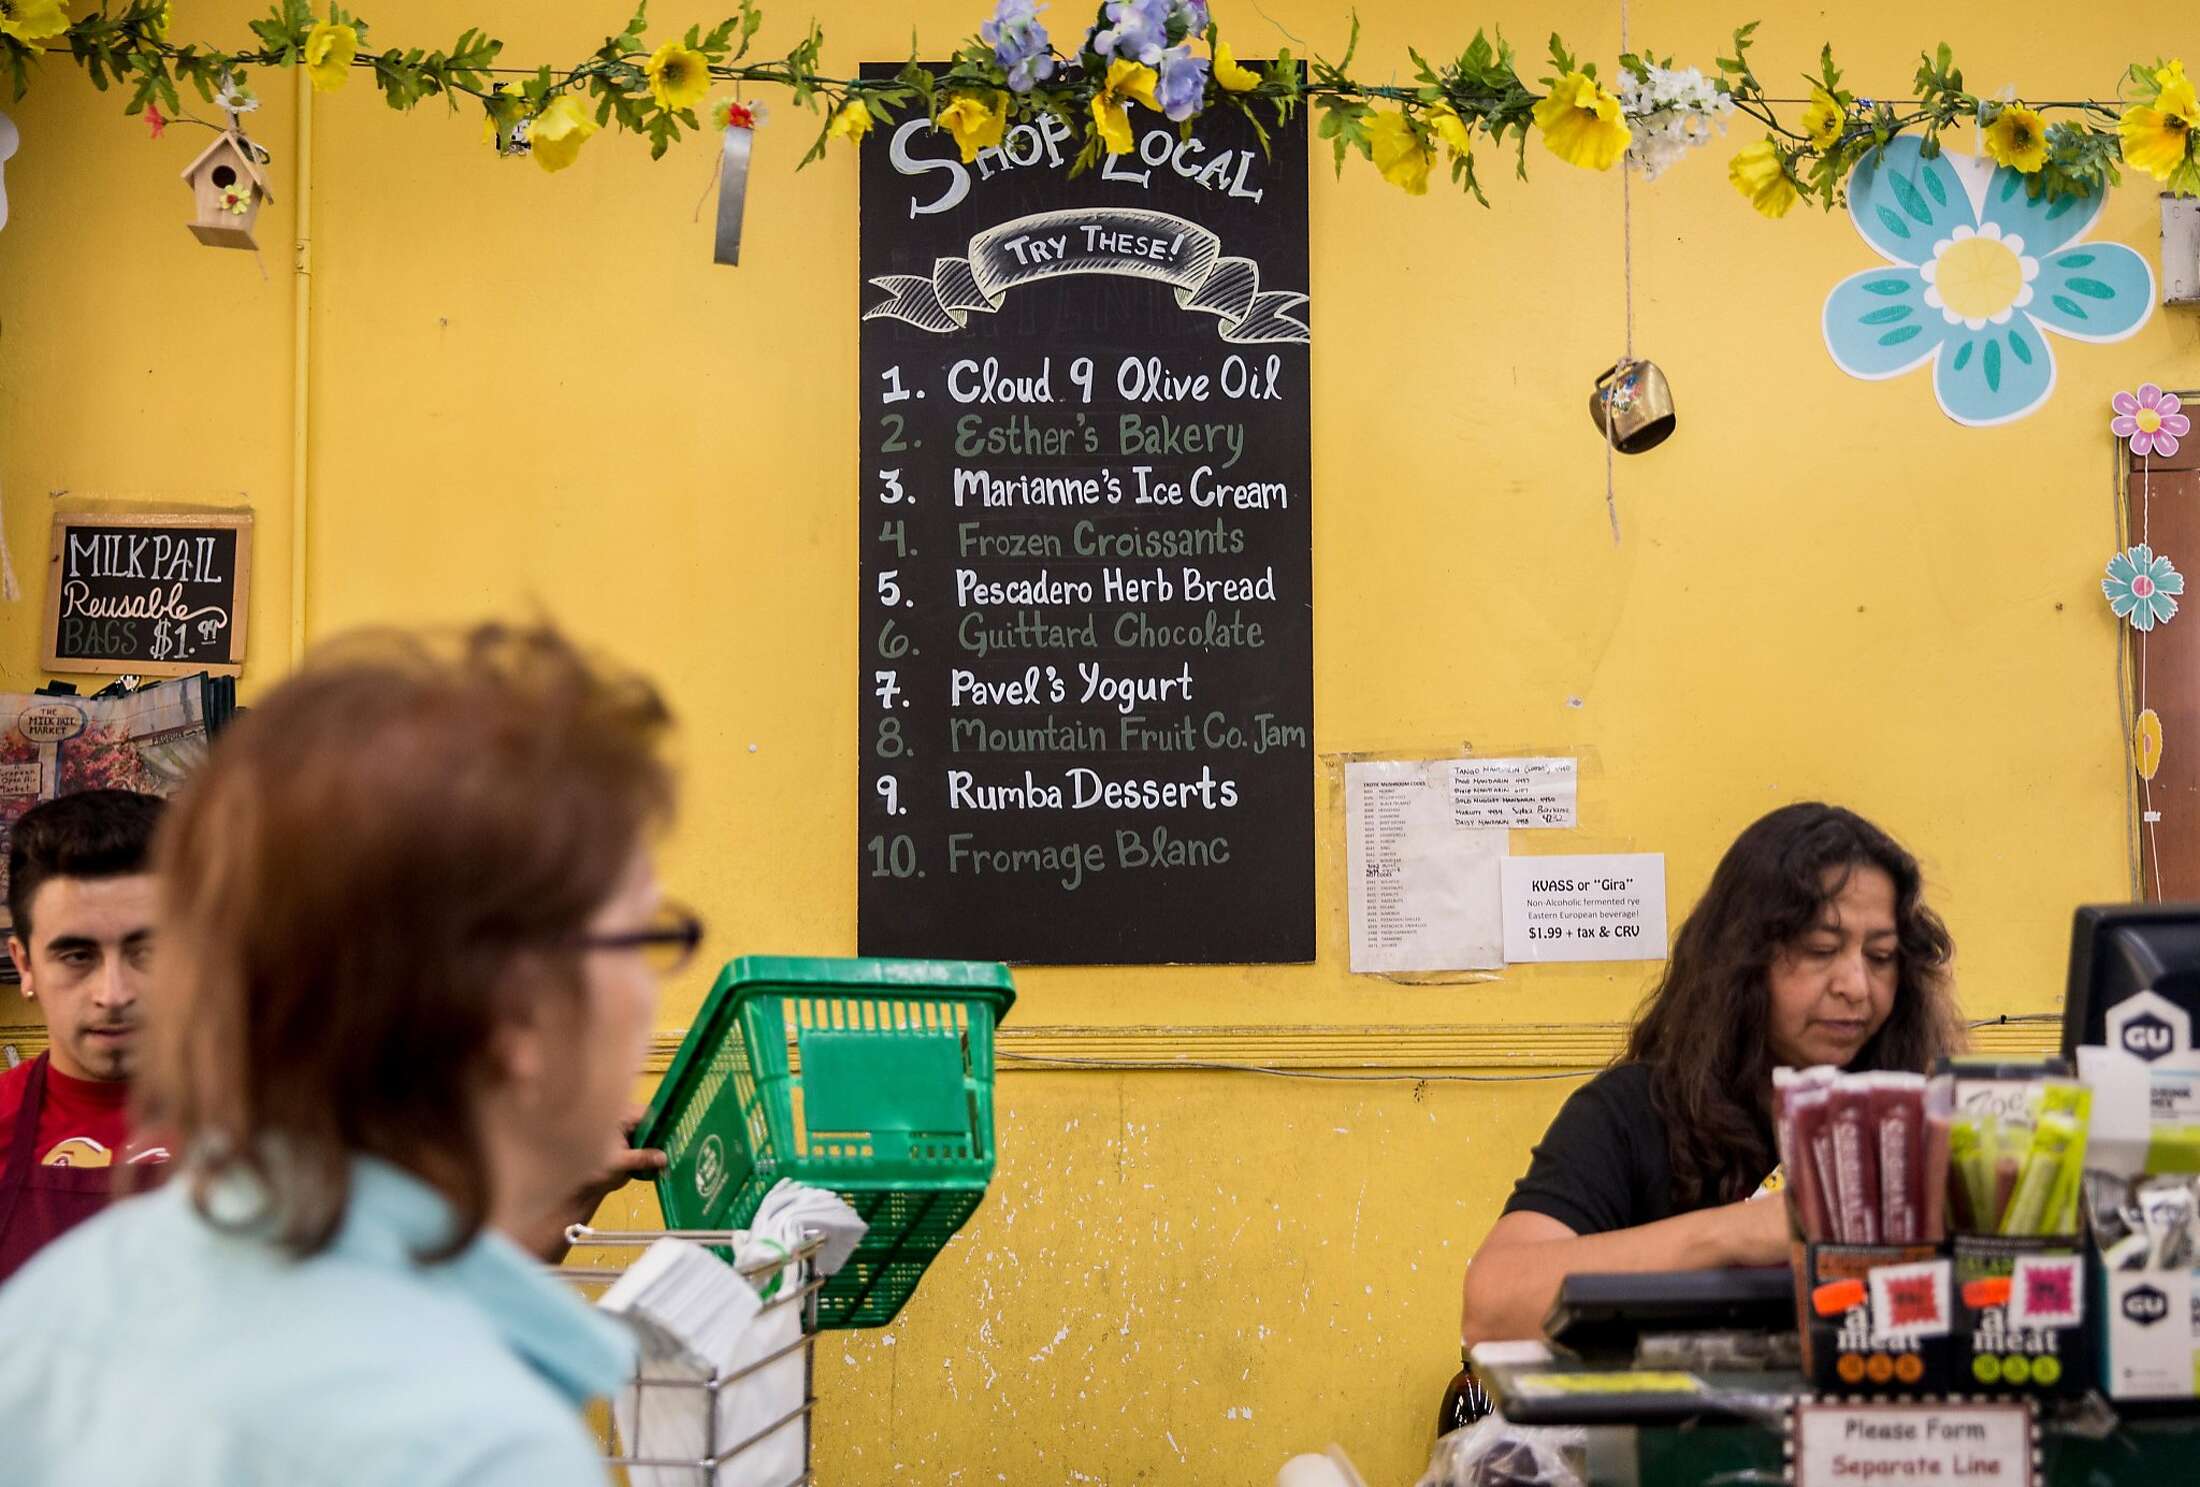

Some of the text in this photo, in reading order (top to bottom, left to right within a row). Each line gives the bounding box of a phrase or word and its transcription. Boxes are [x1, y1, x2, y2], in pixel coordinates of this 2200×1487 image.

[1004, 225, 1185, 265] TRY THESE!
[881, 354, 1283, 404] 1. Cloud 9 Olive Oil
[880, 413, 1244, 468] 2. Esther's Bakery
[879, 465, 1288, 509] 3. Marianne's Ice Cream
[878, 517, 1245, 558] 4. Frozen Croissants
[63, 580, 228, 628] Reusable
[877, 566, 1276, 607] 5. Pescadero Herb Bread
[64, 619, 137, 655] BAGS
[878, 609, 1265, 659] 6. Guittard Chocolate
[875, 662, 1193, 714] 7. Pavel's Yogurt
[876, 711, 1306, 758] 8. Mountain Fruit Co. Jam
[876, 766, 1239, 816] 9. Rumba Desserts
[868, 826, 1231, 891] 10. Fromage Blanc
[1531, 880, 1574, 892] KVASS
[1577, 881, 1591, 892] or
[1583, 897, 1625, 906] fermented
[1528, 911, 1558, 920] Eastern
[1560, 910, 1598, 921] European
[1528, 926, 1563, 939] $1.99
[1577, 927, 1596, 939] tax
[1598, 926, 1611, 938] &
[1614, 925, 1640, 938] CRV
[1845, 1418, 1985, 1440] Please Form
[1831, 1454, 2002, 1478] Separate Line
